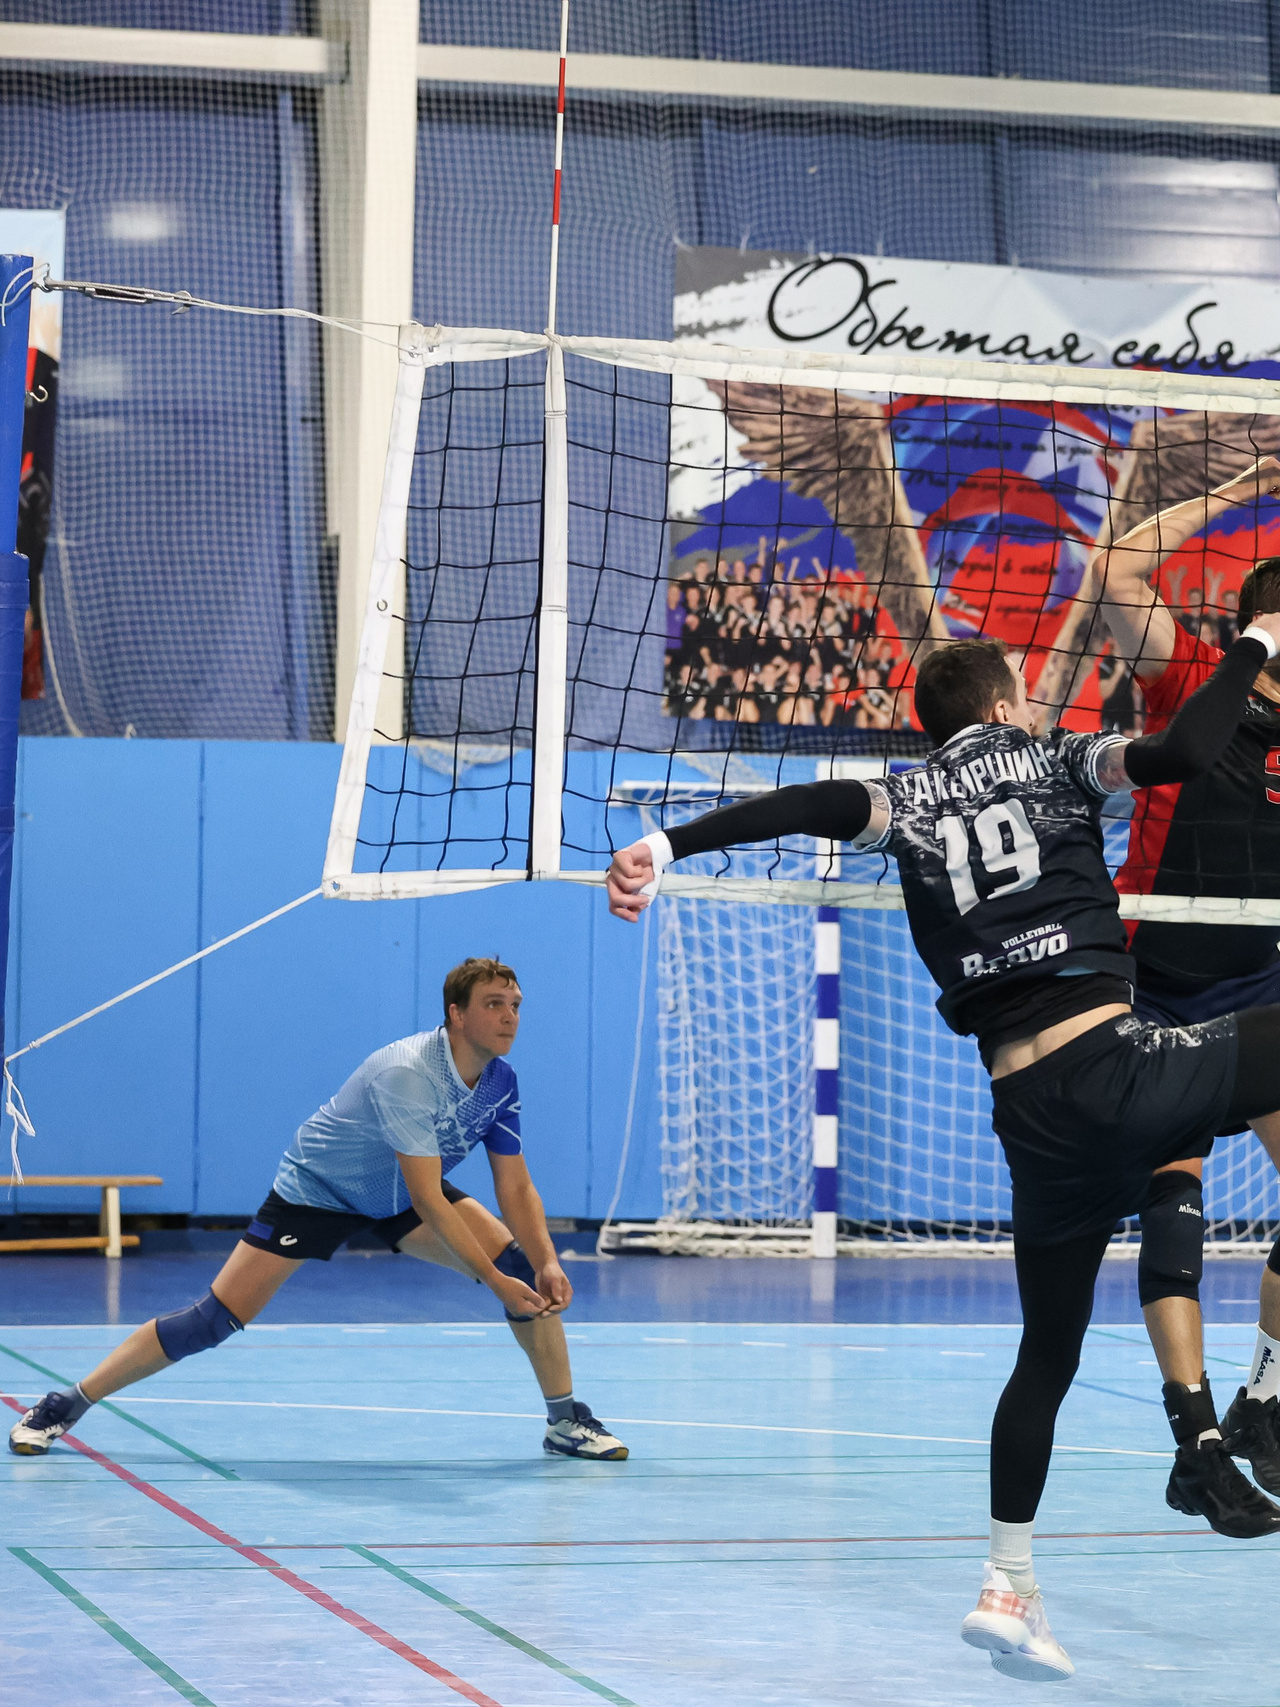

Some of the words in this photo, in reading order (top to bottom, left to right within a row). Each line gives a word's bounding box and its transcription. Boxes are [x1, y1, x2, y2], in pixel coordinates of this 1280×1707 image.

[768, 257, 1093, 364] Обретая
[1111, 302, 1250, 373] себя
[935, 798, 1042, 917] 19
[1001, 922, 1063, 949] VOLLEYBALL
